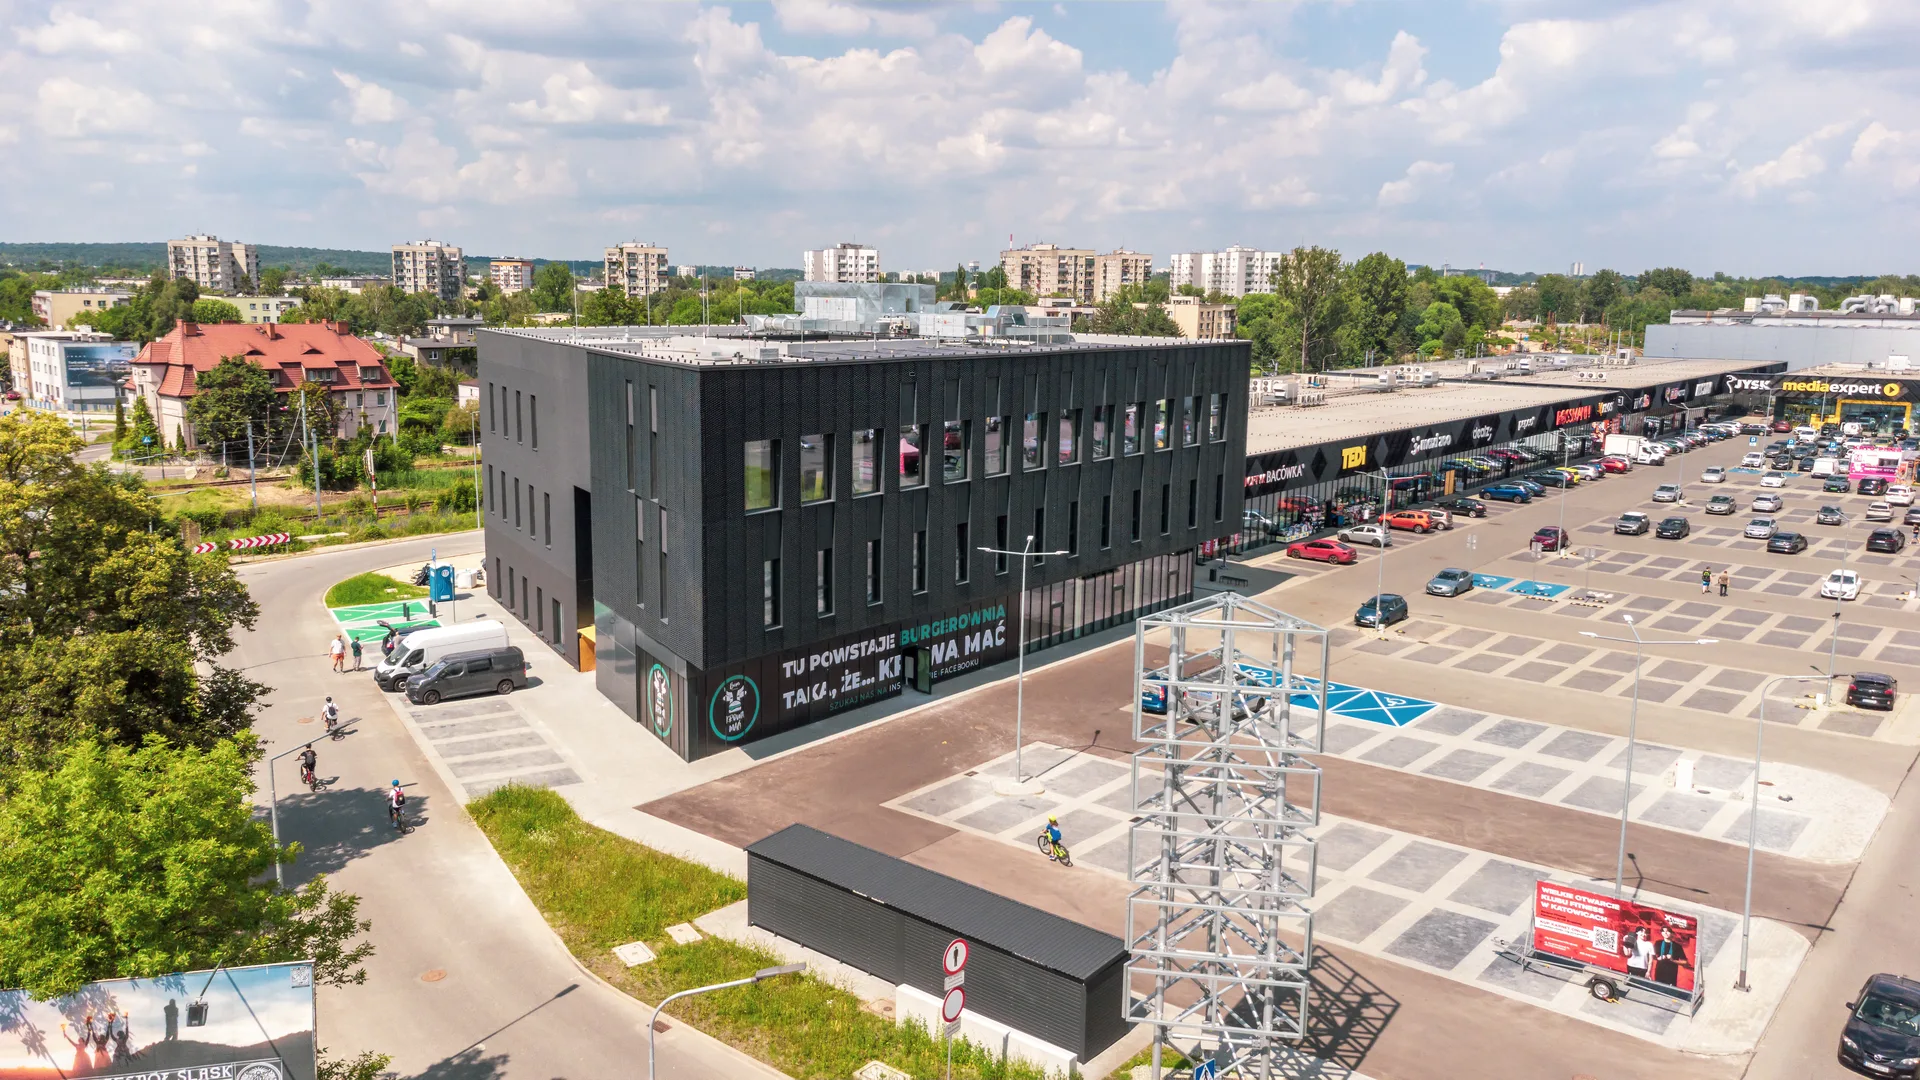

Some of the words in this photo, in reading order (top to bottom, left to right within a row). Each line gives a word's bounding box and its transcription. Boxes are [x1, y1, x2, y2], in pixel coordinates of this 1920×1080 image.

[1734, 379, 1771, 391] JYSK
[1782, 380, 1882, 396] mediaexpert
[1420, 432, 1439, 450] maxi
[1439, 434, 1452, 447] zoo
[1342, 445, 1367, 470] TEDi
[1266, 463, 1303, 484] BACÓWKA
[783, 658, 805, 678] TU
[810, 633, 896, 672] POWSTAJE
[901, 604, 1006, 646] BURGEROWNIA
[964, 620, 1006, 656] MAĆ
[829, 697, 859, 711] SZUKAJ
[860, 691, 875, 700] NAS
[877, 687, 888, 695] NA
[940, 658, 979, 676] FACEBOOKU
[1541, 886, 1574, 900] WIELKIE
[1575, 894, 1620, 911] OTWARCIE
[1541, 894, 1569, 905] KLUBU
[1569, 900, 1605, 914] FITNESS
[1551, 903, 1608, 923] KATOWICACH
